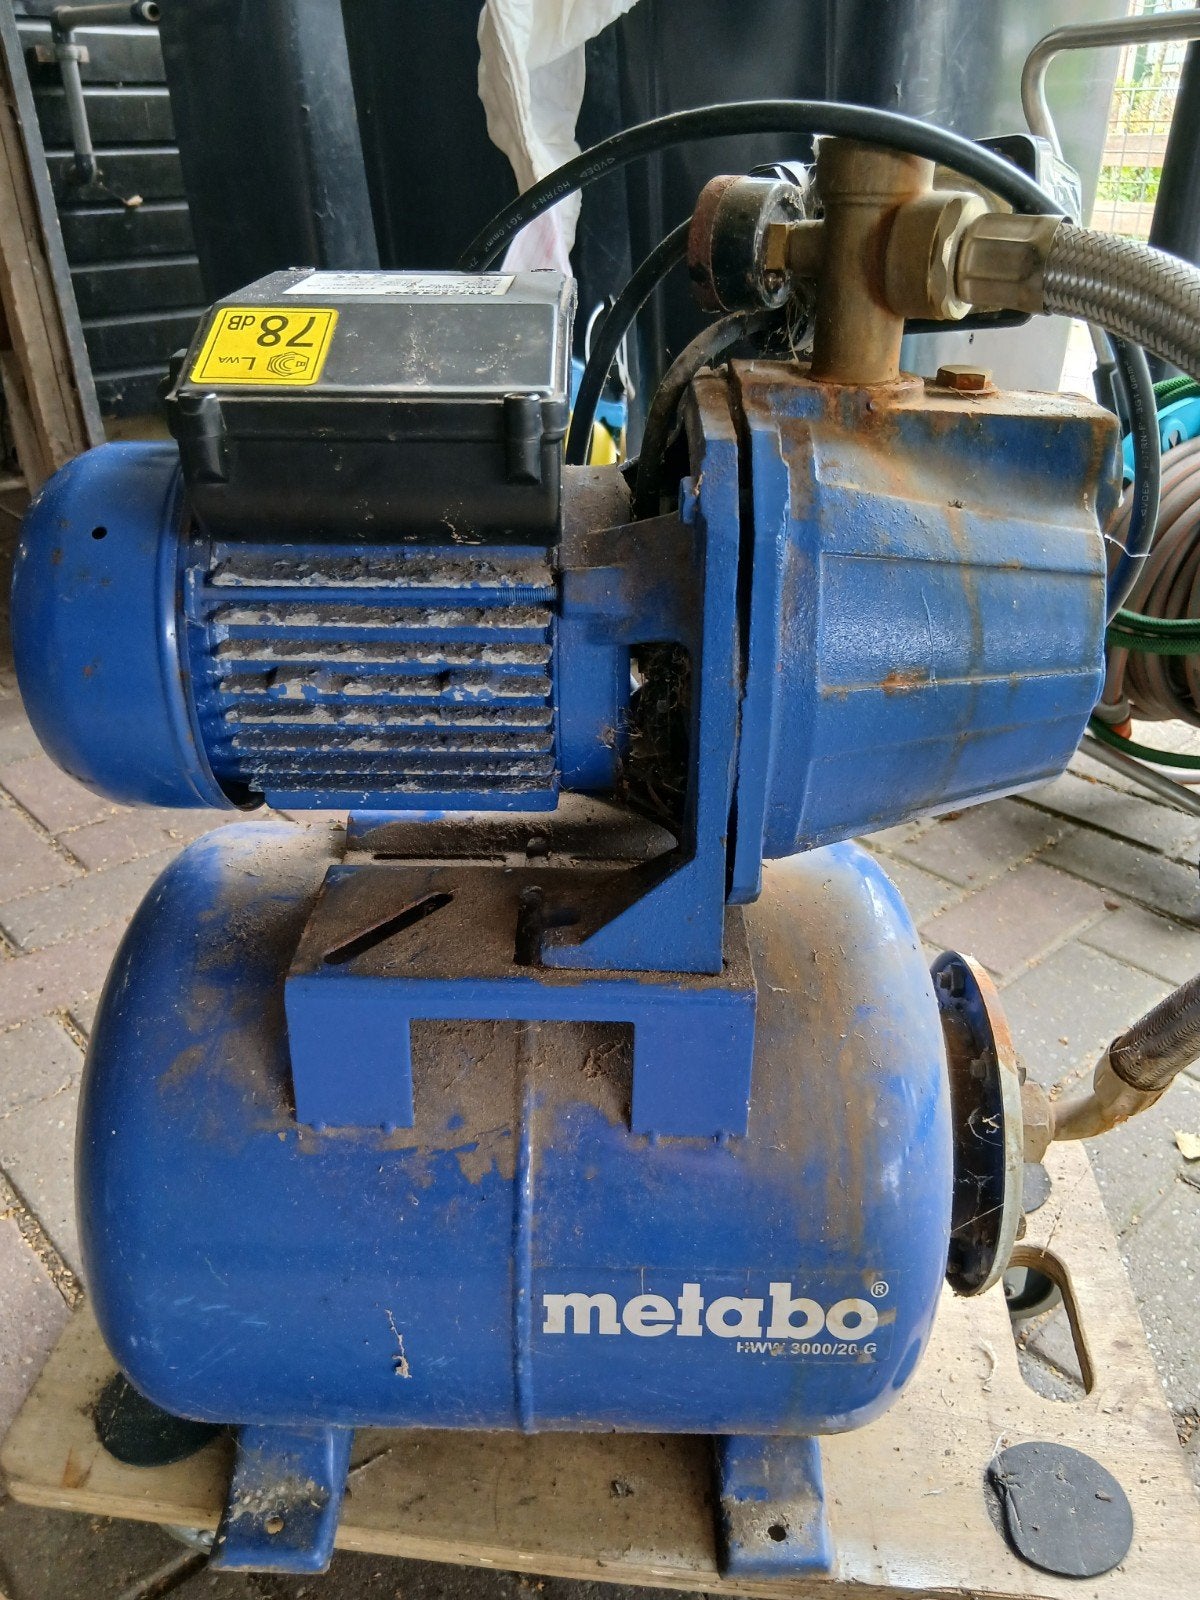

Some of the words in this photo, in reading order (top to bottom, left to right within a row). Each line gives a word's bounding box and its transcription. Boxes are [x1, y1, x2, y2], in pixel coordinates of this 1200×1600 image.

[227, 314, 256, 331] dB
[256, 315, 316, 348] 78
[736, 1341, 786, 1354] HWW
[790, 1342, 858, 1356] 3000/20
[863, 1342, 878, 1355] G
